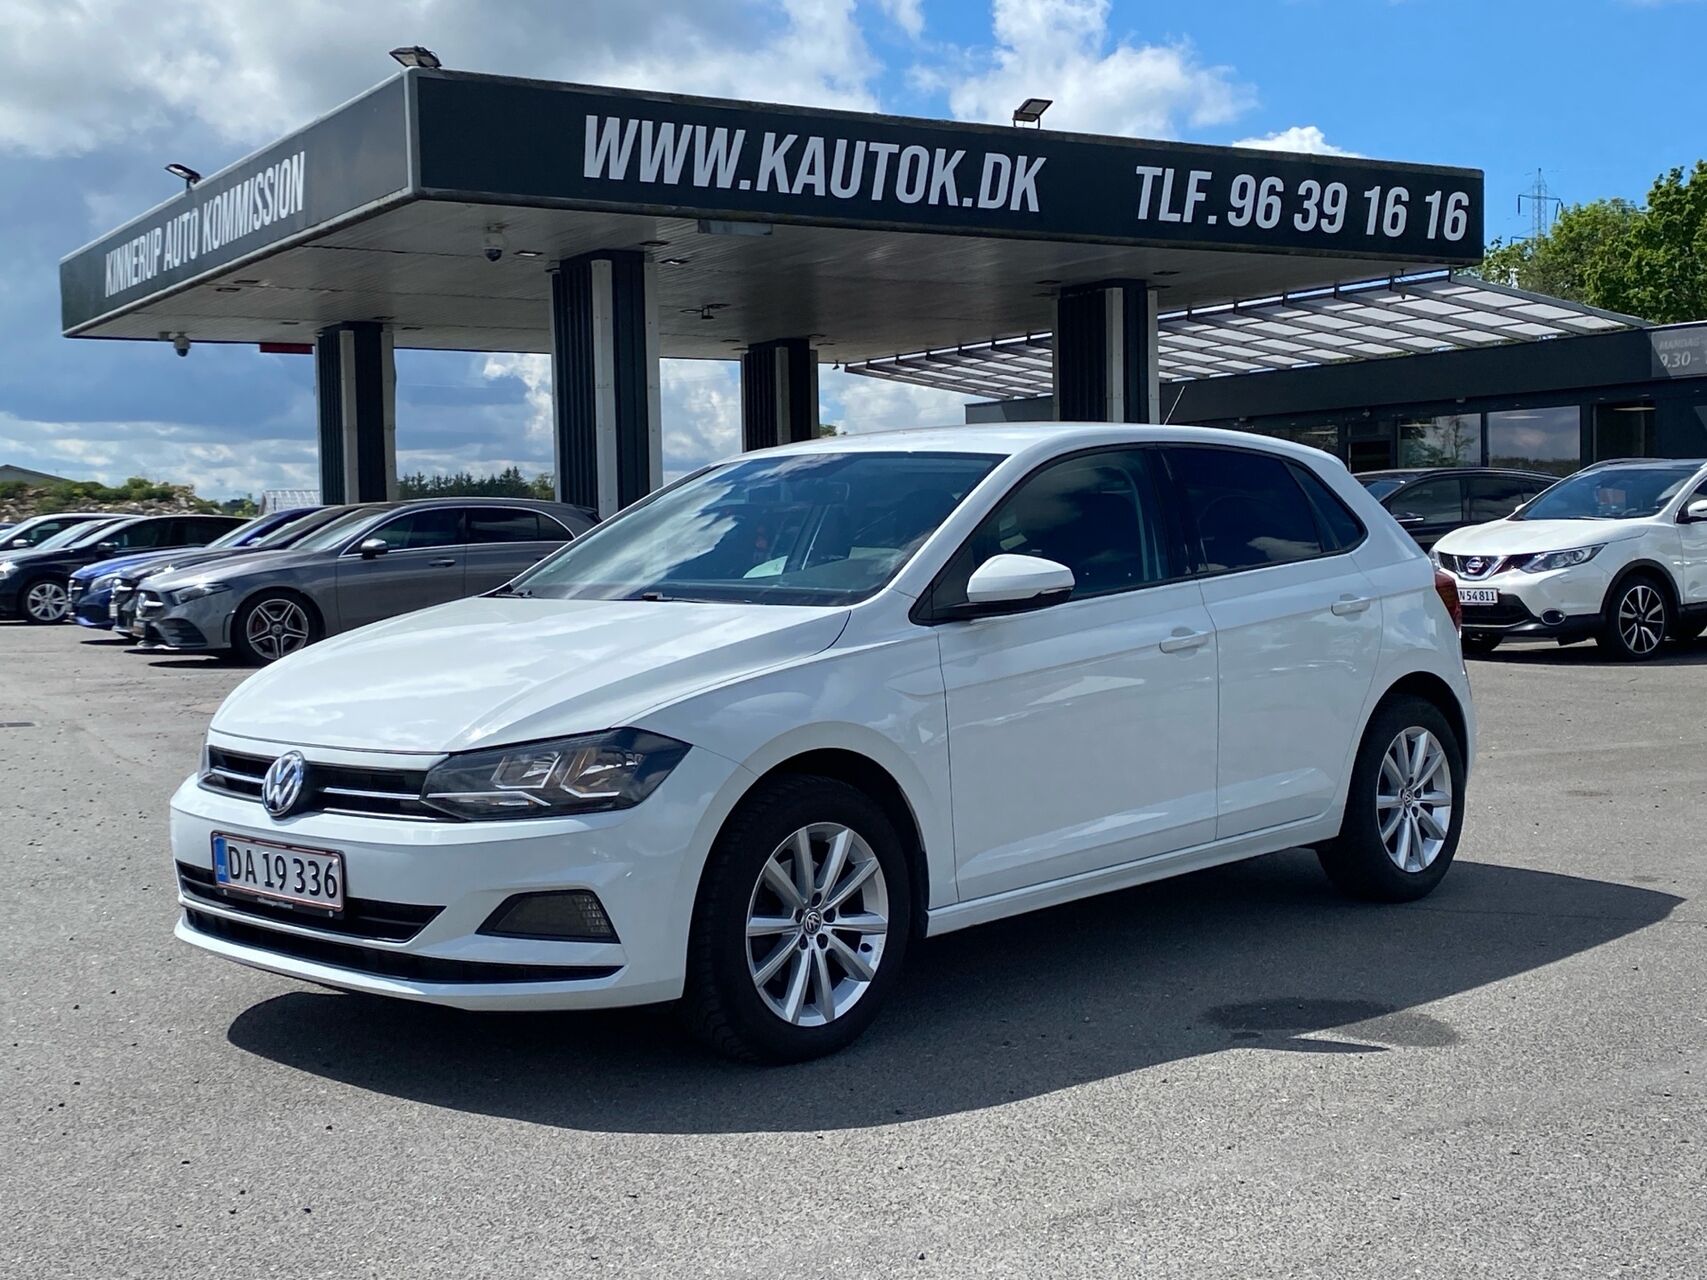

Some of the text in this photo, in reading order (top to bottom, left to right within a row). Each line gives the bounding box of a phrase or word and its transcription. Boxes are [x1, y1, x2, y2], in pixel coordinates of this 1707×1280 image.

[584, 114, 1047, 213] WWW.KAUTOK.DK
[1136, 165, 1470, 242] TLF. 96 39 16 16
[105, 151, 305, 298] KINNERUP AUTO KOMMISSION
